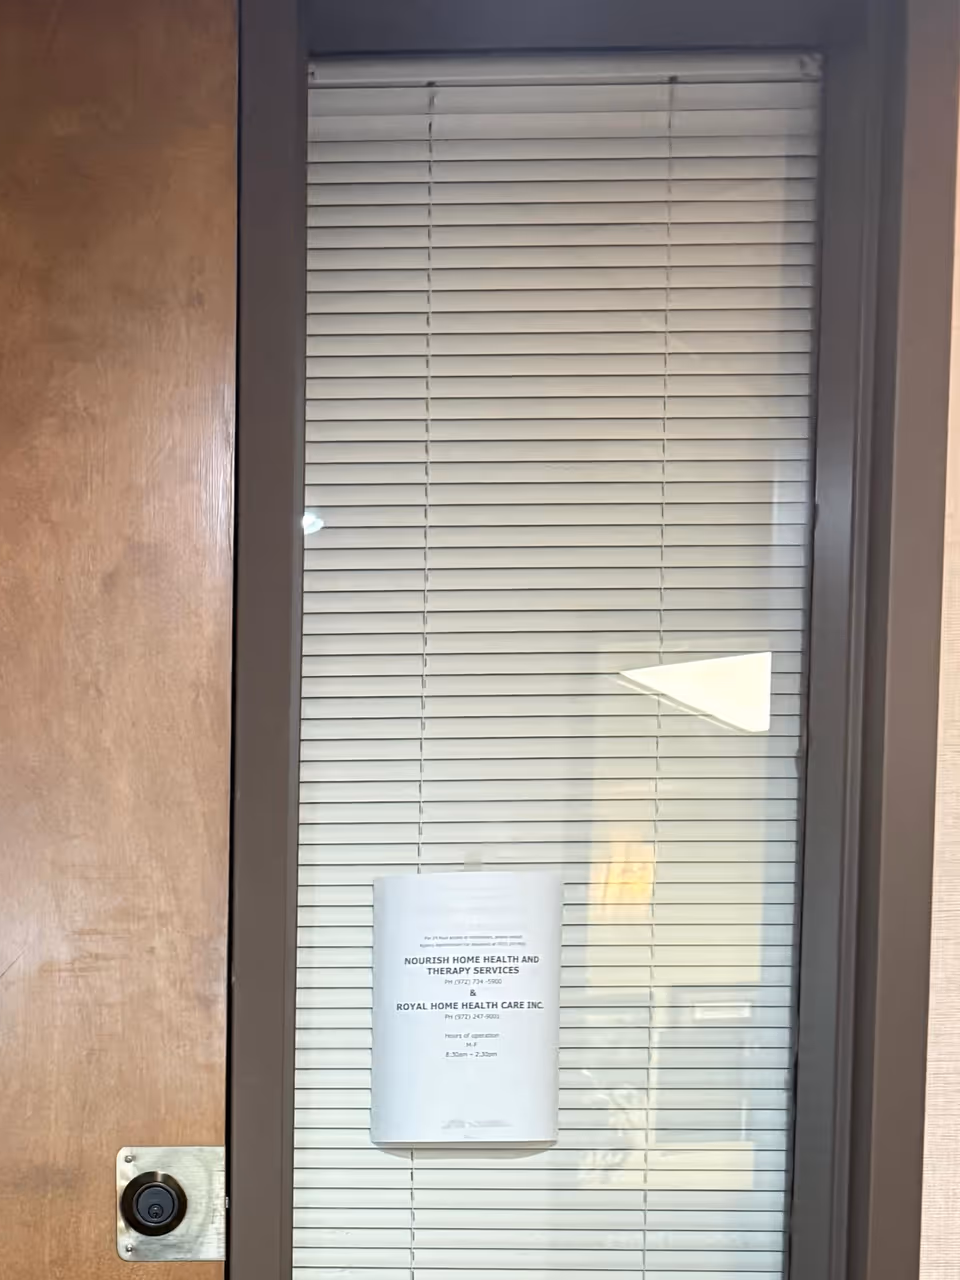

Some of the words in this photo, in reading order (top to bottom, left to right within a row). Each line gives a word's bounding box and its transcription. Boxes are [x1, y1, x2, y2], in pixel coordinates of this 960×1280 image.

[404, 957, 450, 965] NOURISH
[452, 956, 481, 964] HOME
[483, 956, 519, 964] HEALTH
[427, 967, 471, 975] THERAPY
[396, 1003, 428, 1011] ROYAL
[431, 1002, 459, 1010] HOME
